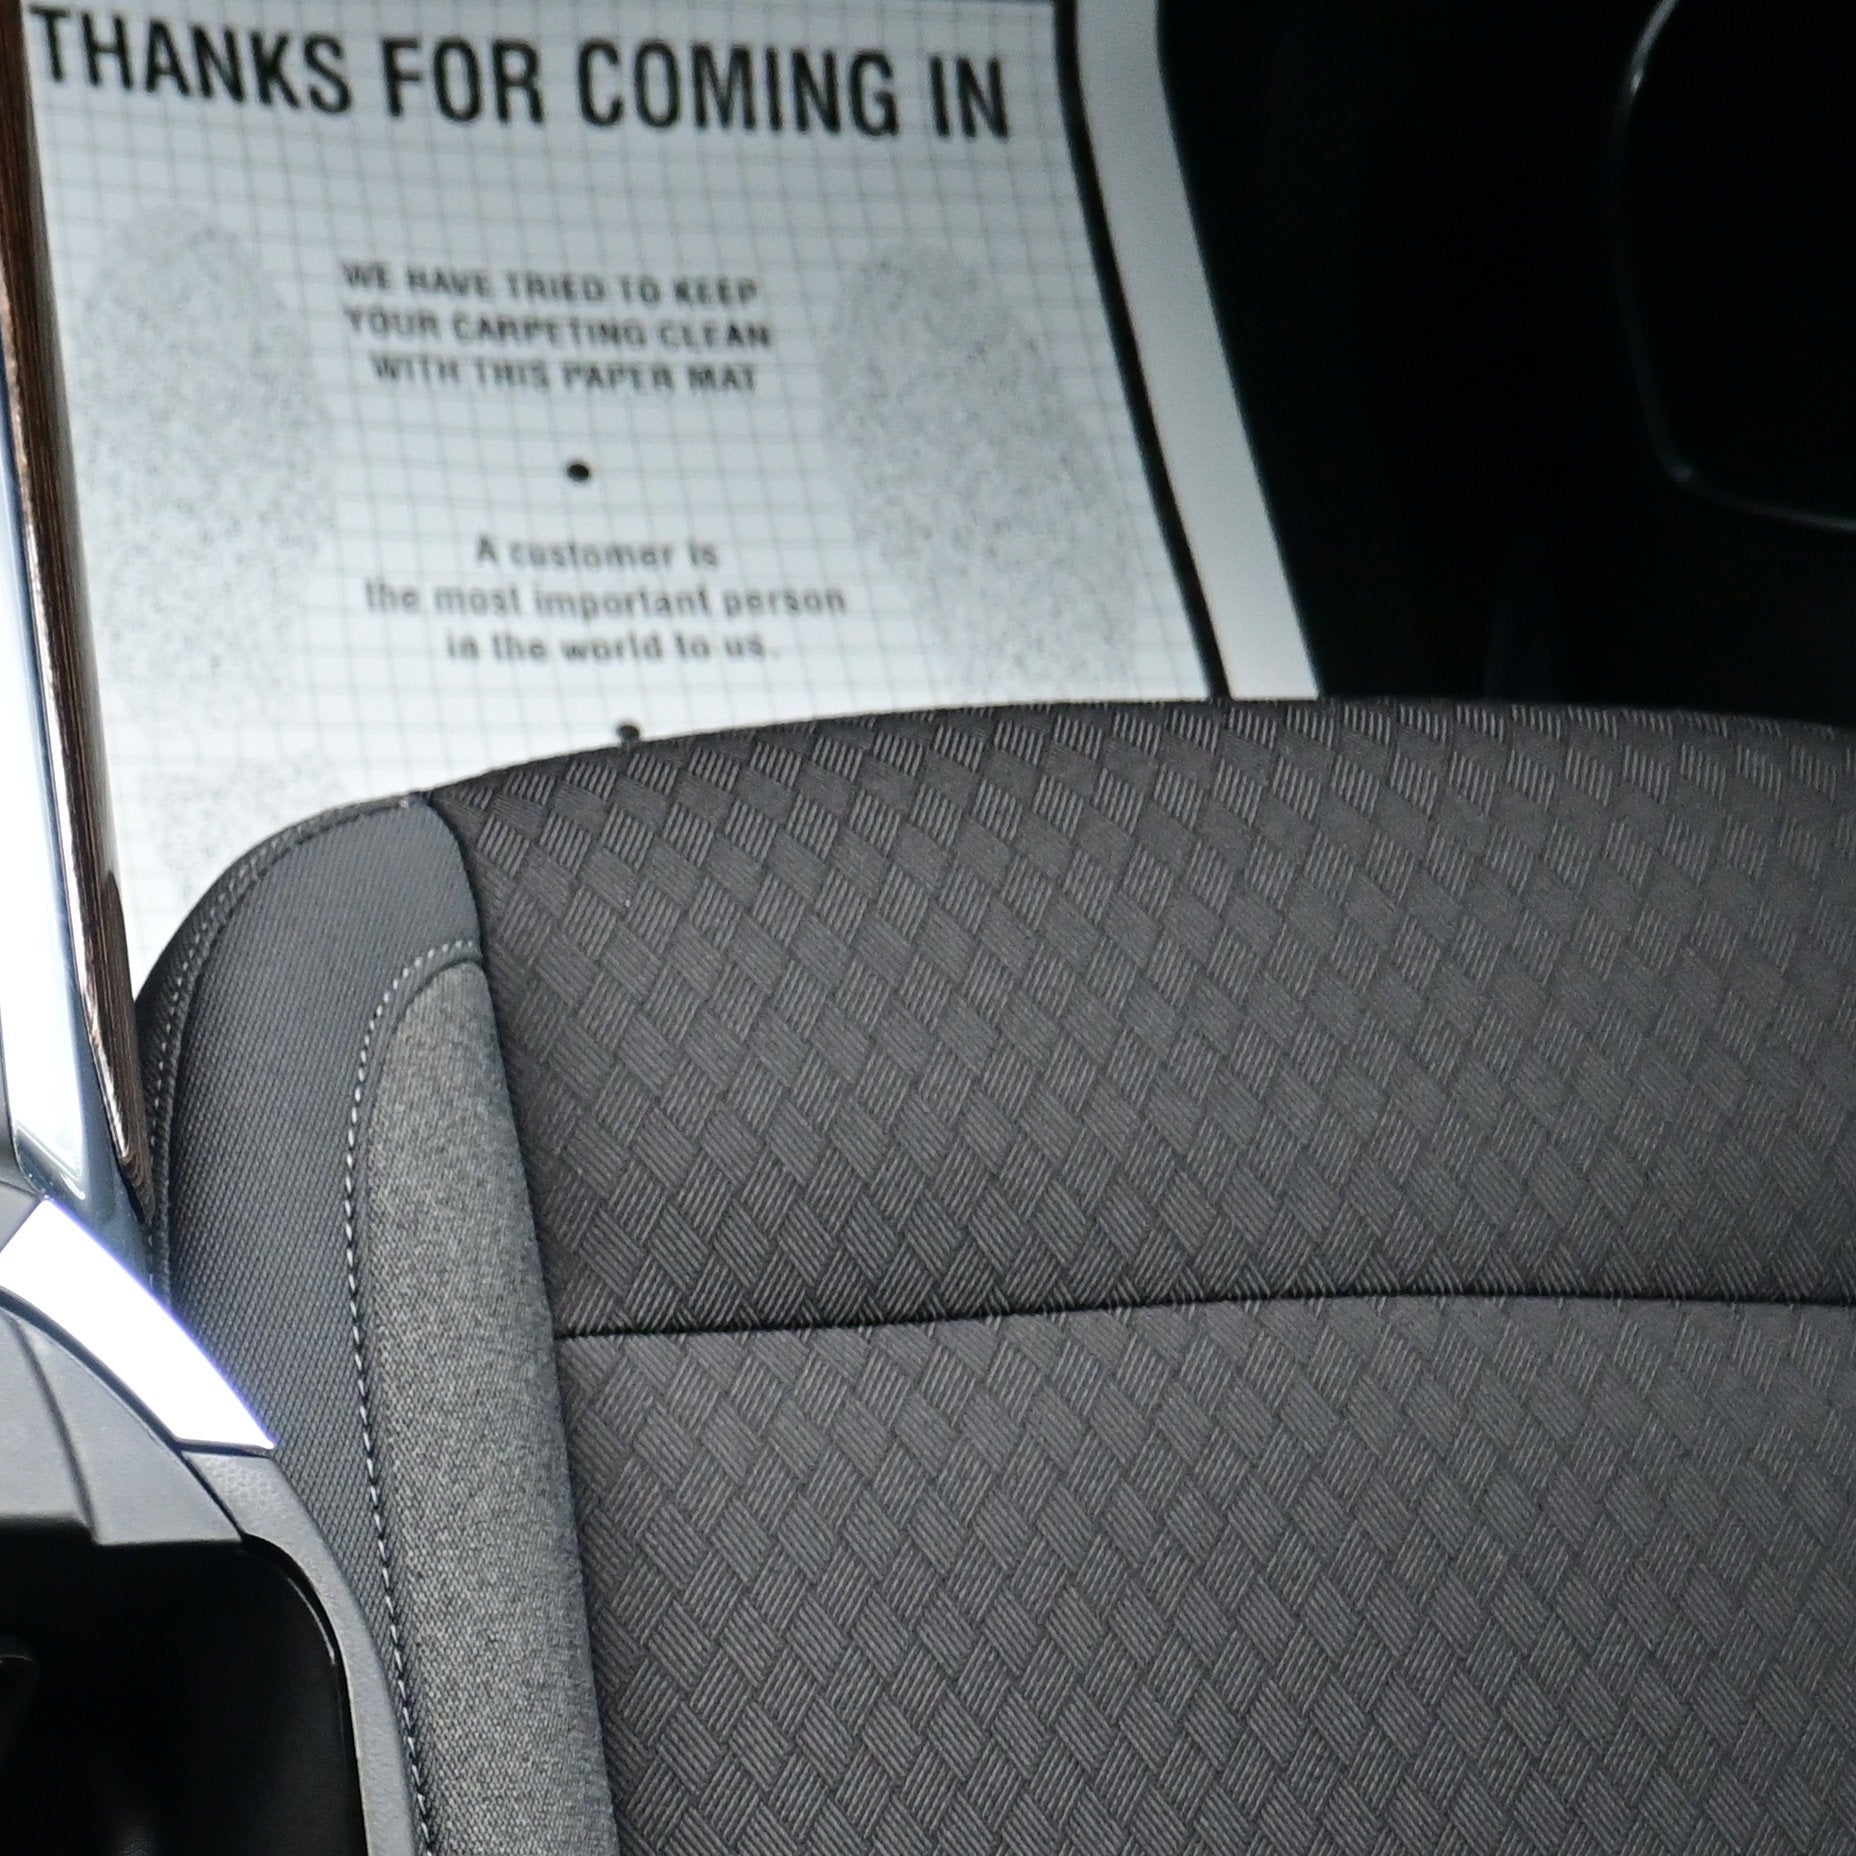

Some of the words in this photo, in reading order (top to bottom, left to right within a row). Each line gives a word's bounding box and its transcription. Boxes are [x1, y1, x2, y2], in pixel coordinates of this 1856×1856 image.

[31, 4, 352, 114] THANKS
[381, 36, 544, 125] FOR
[576, 37, 899, 139] COMING
[928, 53, 1010, 140] IN
[341, 259, 392, 291] WE
[406, 264, 490, 298] HAVE
[506, 269, 606, 303] TRIED
[622, 274, 662, 307] TO
[672, 274, 758, 306] KEEP
[343, 306, 441, 339] YOUR
[452, 311, 646, 348] CARPETING
[658, 319, 772, 350] CLEAN
[370, 351, 460, 385] WITH
[474, 356, 550, 391] THIS
[563, 360, 675, 393] PAPER
[688, 362, 757, 393] MAT
[476, 535, 499, 566] A
[510, 537, 674, 571] customer
[689, 539, 720, 569] is
[365, 581, 419, 614] the
[435, 583, 521, 617] most
[535, 583, 712, 622] important
[724, 586, 847, 620] person
[493, 629, 548, 662] the
[560, 631, 664, 663] world
[675, 631, 710, 661] to
